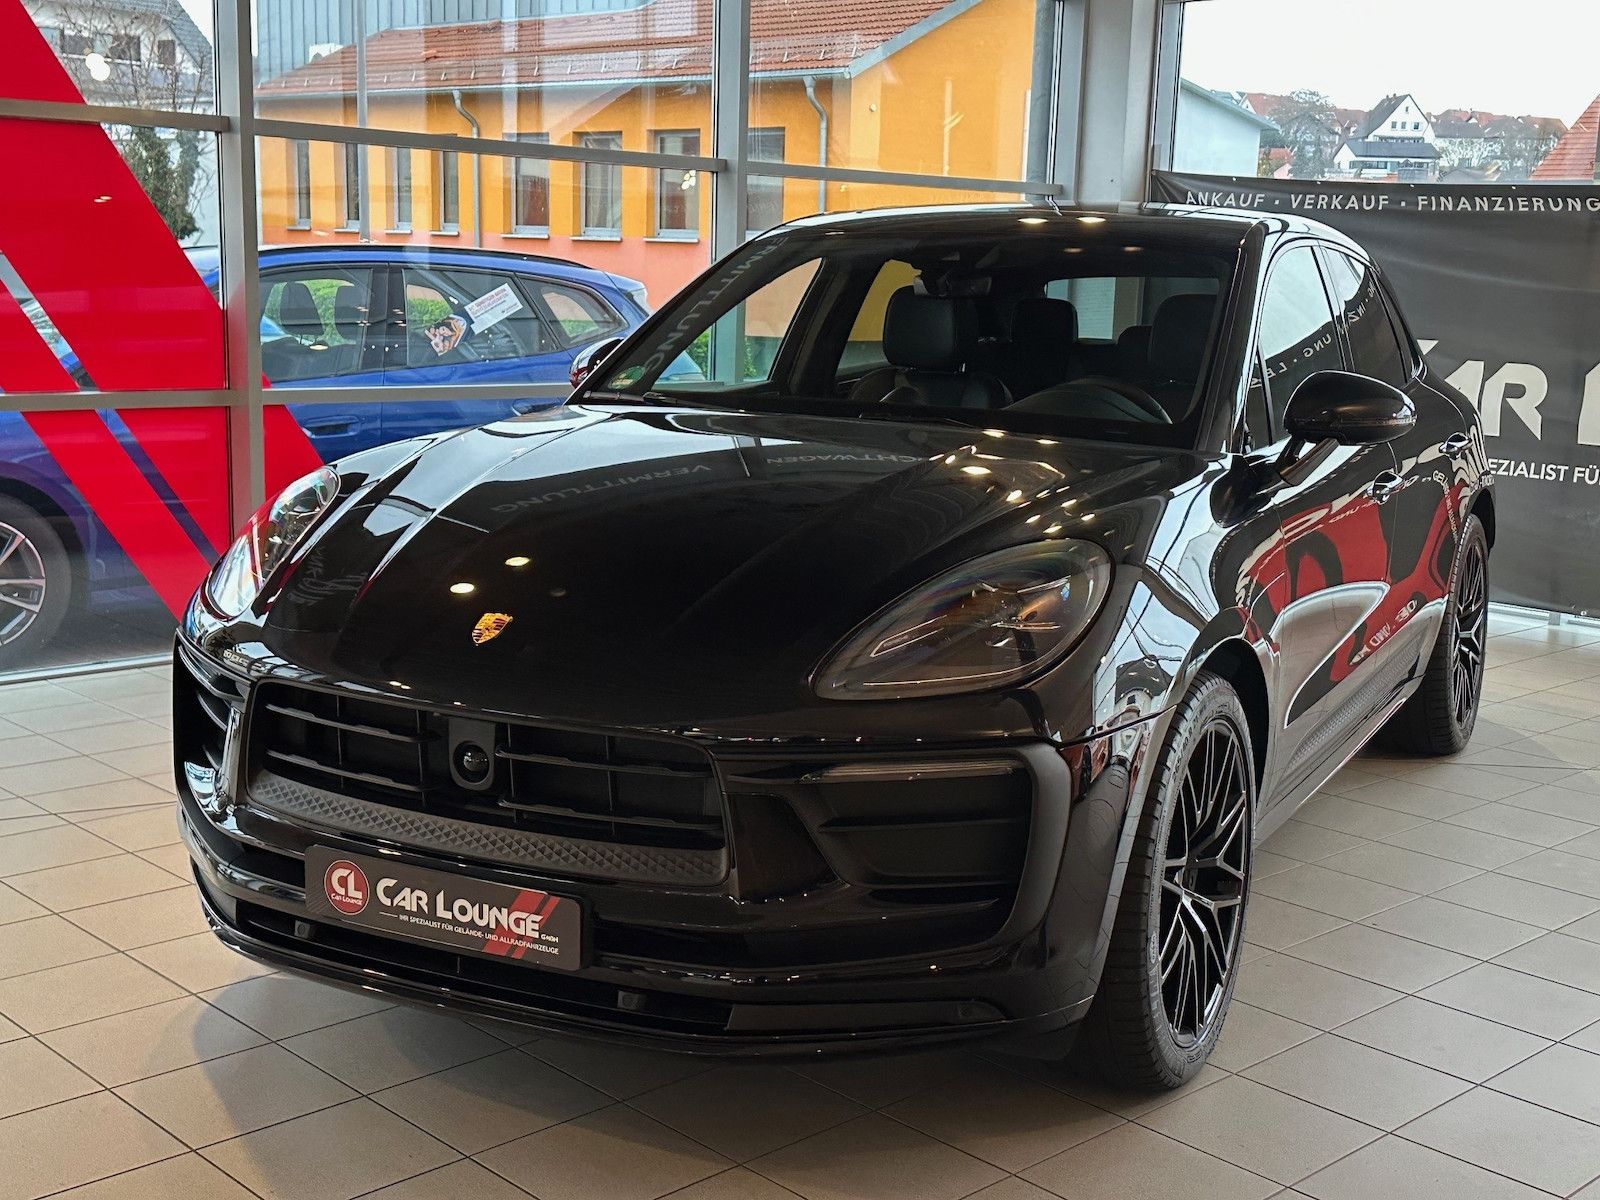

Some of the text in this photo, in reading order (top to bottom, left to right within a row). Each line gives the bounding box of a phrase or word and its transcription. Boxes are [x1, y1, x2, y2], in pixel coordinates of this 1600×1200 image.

[1185, 190, 1600, 212] ANKAUF VERKAUF FINANZIERUNG
[1487, 458, 1600, 486] EZIALIST FÜ
[491, 464, 711, 513] VERMITTLUNG
[331, 868, 363, 900] CL
[399, 914, 559, 955] IHR SPEZIALIST FÜR GELÄNDE- UND ALLRADFAHRZEUGE
